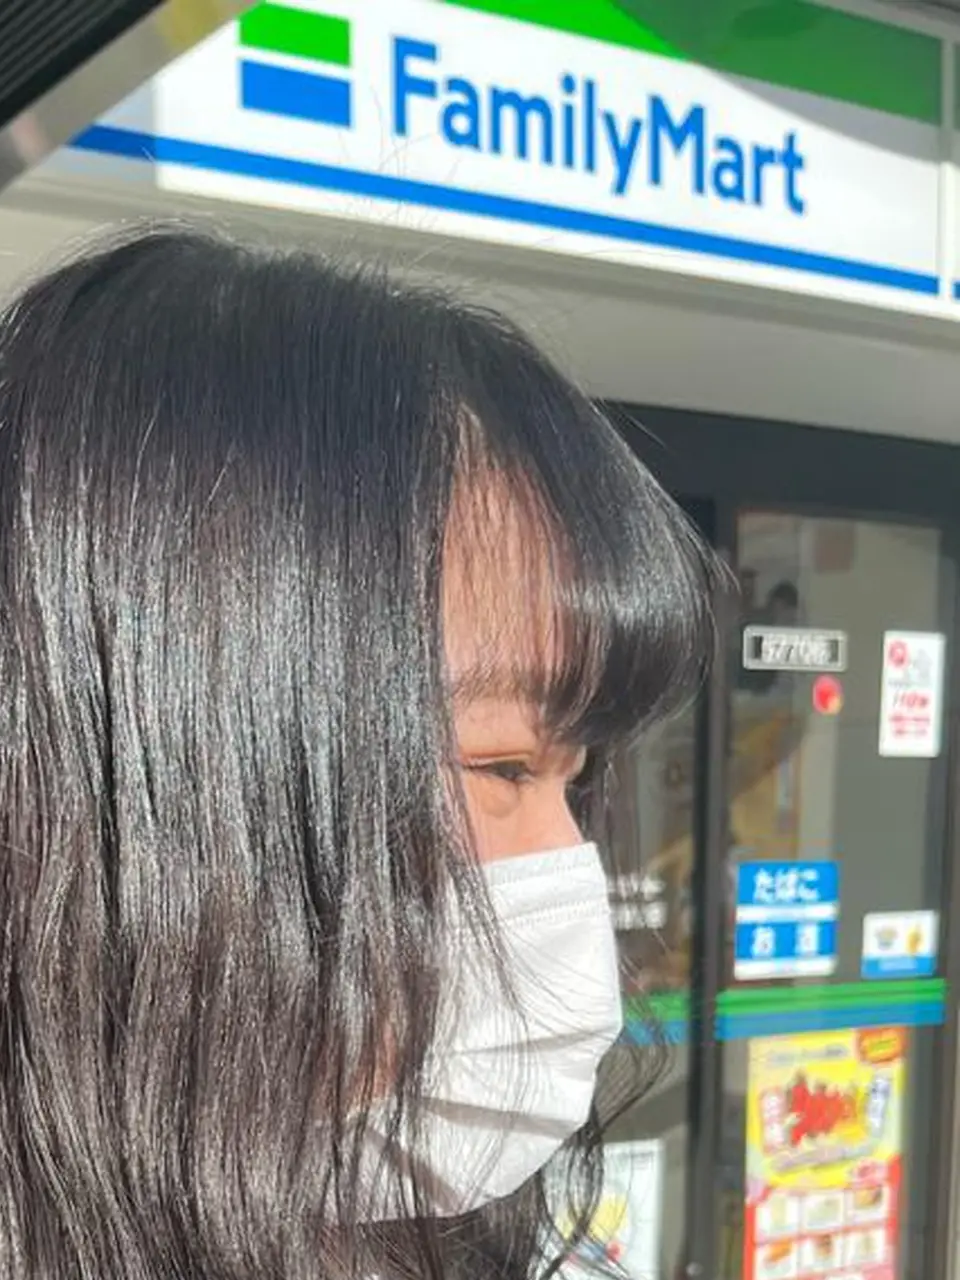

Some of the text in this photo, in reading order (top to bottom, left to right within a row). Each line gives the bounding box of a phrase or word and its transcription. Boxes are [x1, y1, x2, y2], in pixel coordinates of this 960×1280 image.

[391, 35, 806, 216] FamilyMart
[753, 867, 820, 904] たばこ
